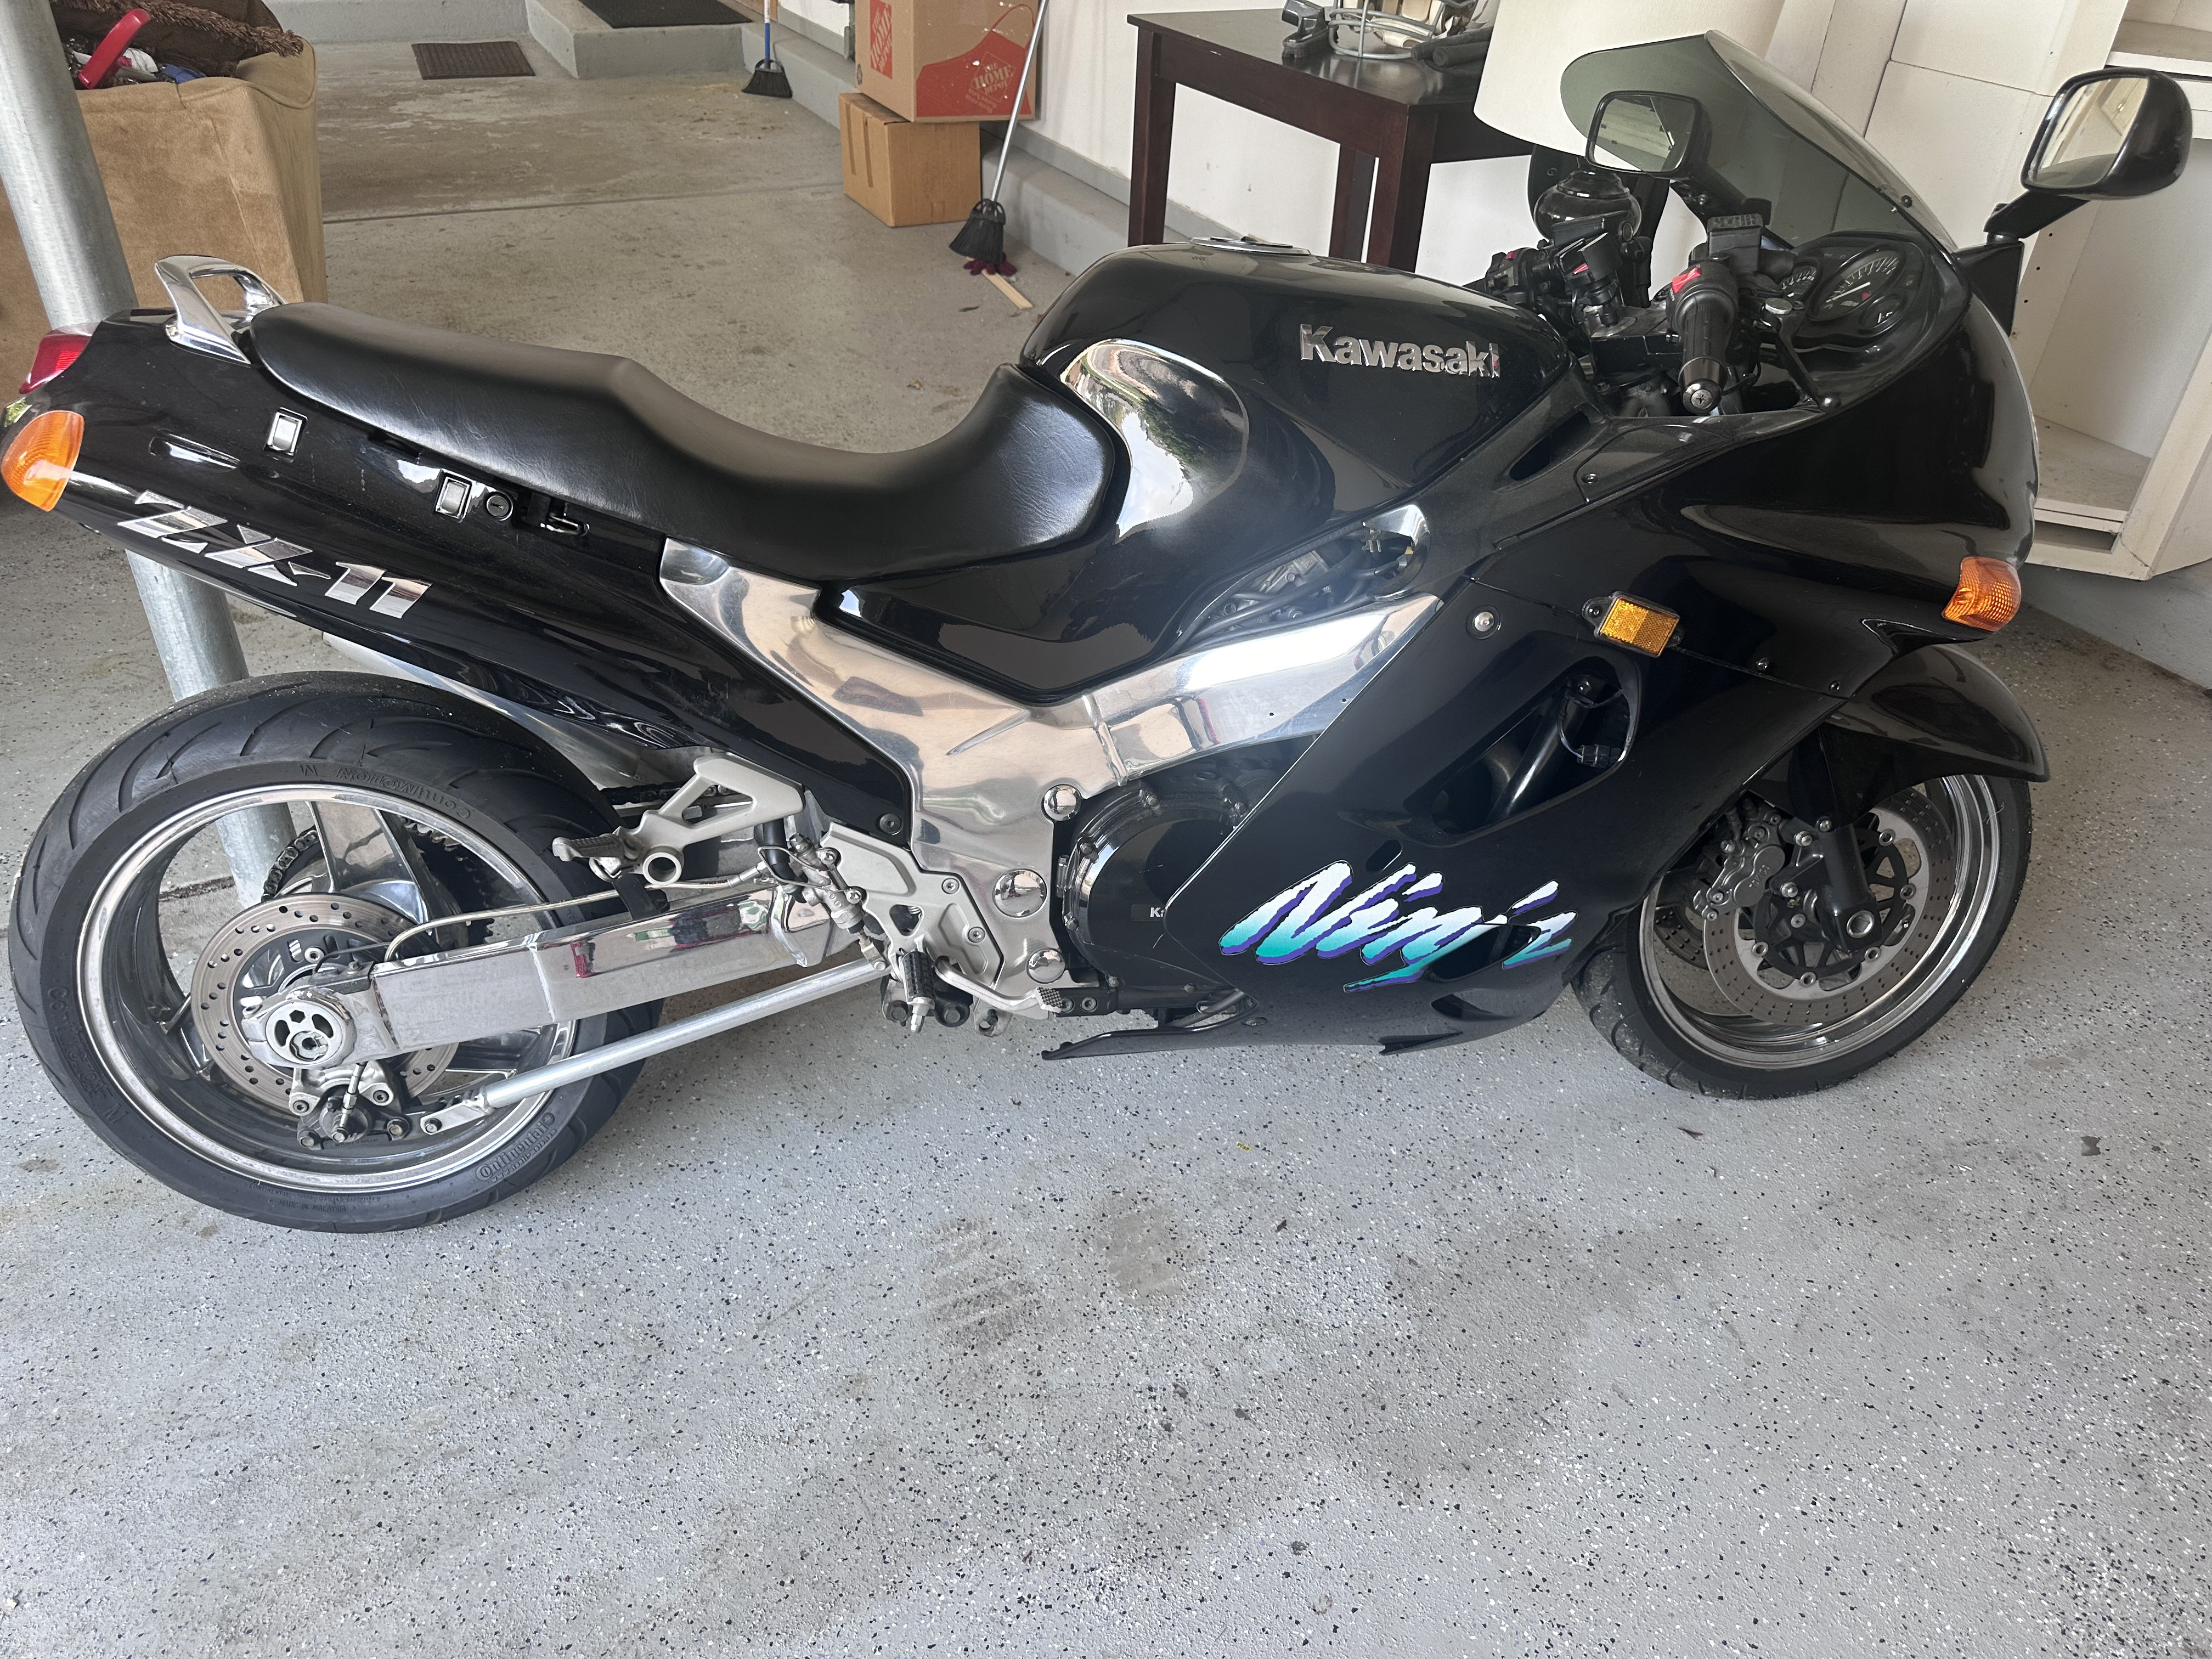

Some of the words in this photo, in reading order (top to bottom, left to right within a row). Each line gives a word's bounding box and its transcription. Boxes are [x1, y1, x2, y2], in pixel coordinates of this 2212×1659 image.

[974, 65, 1013, 89] HOME
[984, 80, 1008, 95] DEPOT
[1300, 324, 1500, 379] Kawasaki
[117, 489, 433, 619] ZX-11
[1218, 860, 1577, 994] Ninja
[476, 1120, 549, 1181] Continental
[278, 1198, 298, 1209] MADE
[312, 1204, 347, 1212] MALAYSIA
